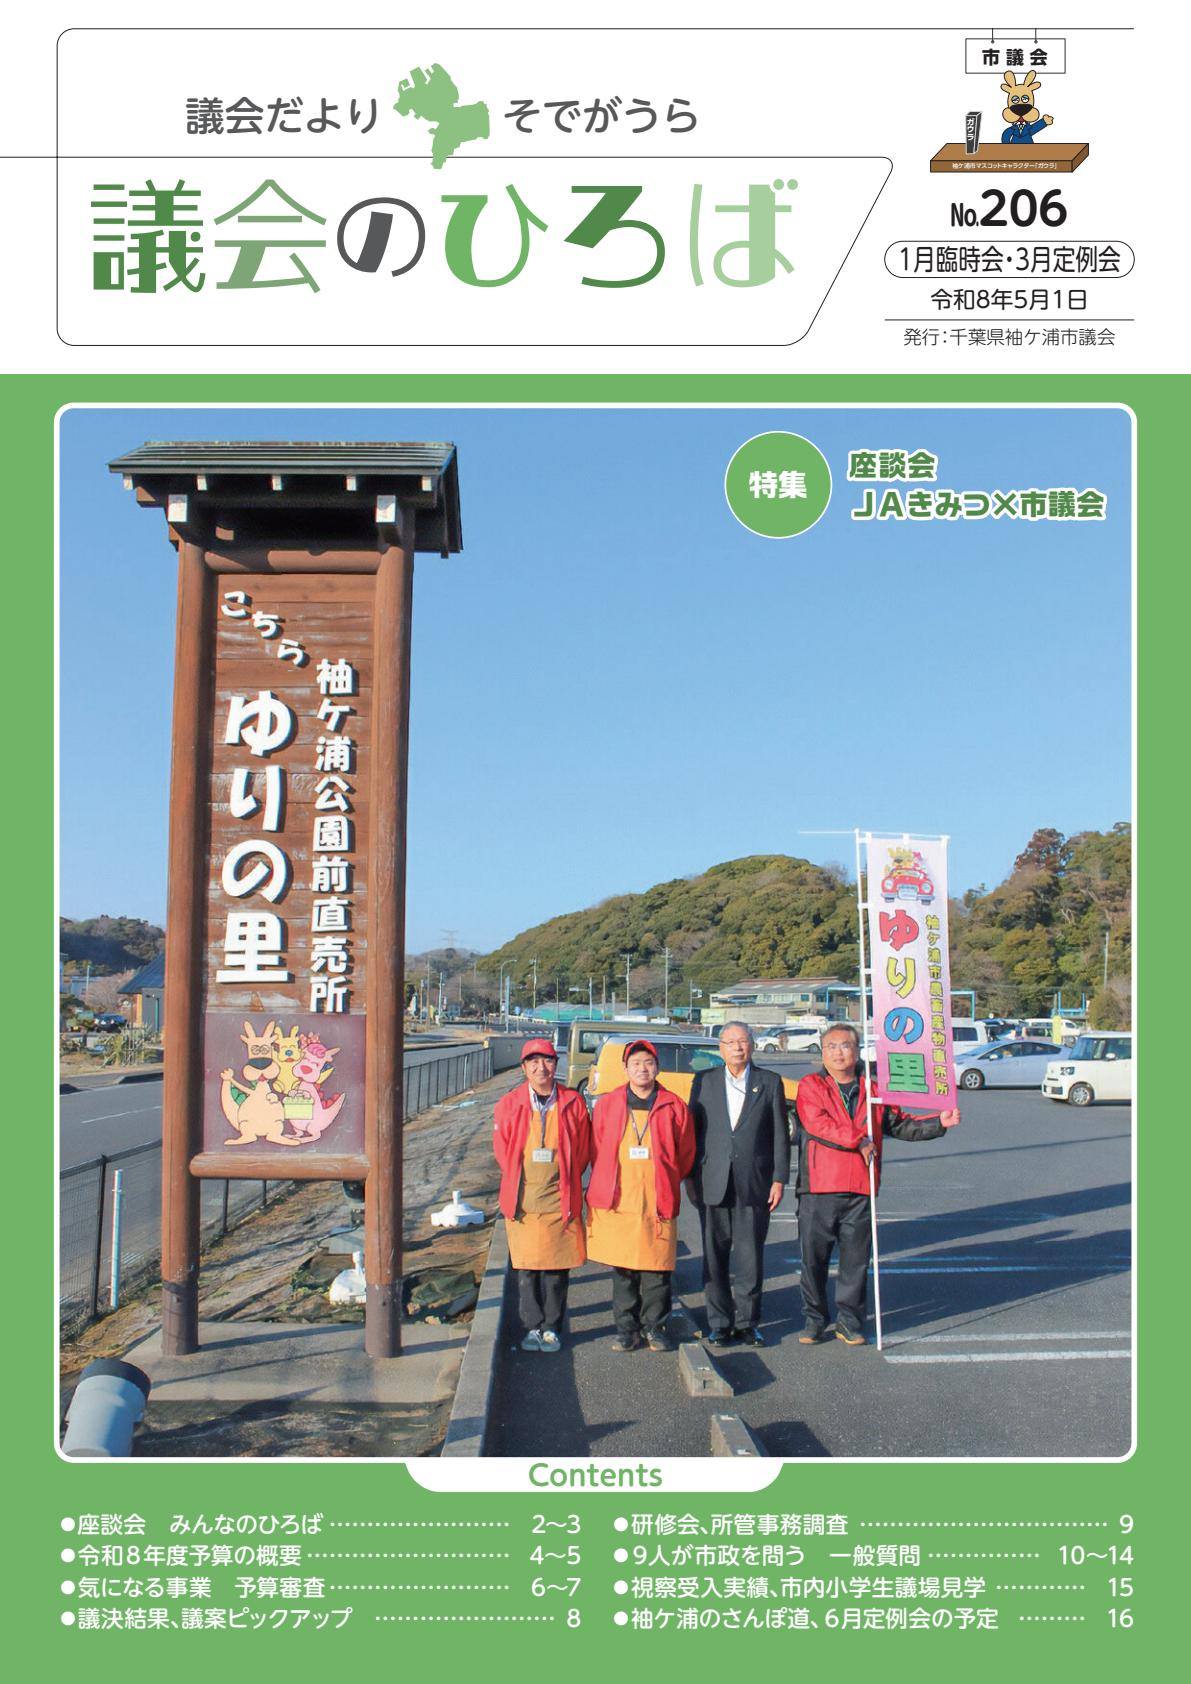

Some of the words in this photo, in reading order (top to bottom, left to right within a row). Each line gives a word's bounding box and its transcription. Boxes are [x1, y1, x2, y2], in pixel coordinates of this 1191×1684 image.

[982, 48, 1048, 66] 市議会
[186, 96, 377, 135] 議会だより
[504, 96, 697, 134] そでがうら
[966, 118, 975, 141] ガウラ
[90, 178, 799, 294] 議会のひろば
[900, 246, 1121, 273] 1月臨時会・3月定例会
[931, 288, 1087, 310] 令和8年5月1日
[220, 591, 306, 666] こちら
[216, 690, 292, 983] ゆりの里
[310, 658, 353, 1013] 袖ケ浦公園前直売所
[879, 909, 930, 1094] ゆりの里
[528, 1462, 663, 1488] Contents
[78, 1514, 146, 1536] 座談会
[170, 1513, 324, 1535] みんなのひろば
[631, 1514, 849, 1536] 研修会、所管事務調査
[1119, 1514, 1134, 1534] 9
[78, 1545, 302, 1567] 令和8年度予算の概要
[632, 1544, 805, 1567] 9人が市政を問う
[830, 1545, 921, 1567] 一般質問
[78, 1577, 212, 1599] 気になる事業
[235, 1577, 325, 1599] 予算審査
[631, 1577, 986, 1599] 視察受入実績、市内小学生議場見学
[1108, 1578, 1134, 1597] 15
[78, 1607, 353, 1630] 議決結果、議案ピックアップ
[567, 1609, 581, 1628] 8
[631, 1607, 999, 1630] 袖ケ浦のさんぽ道、6月定例会の予定
[1108, 1609, 1134, 1628] 16
